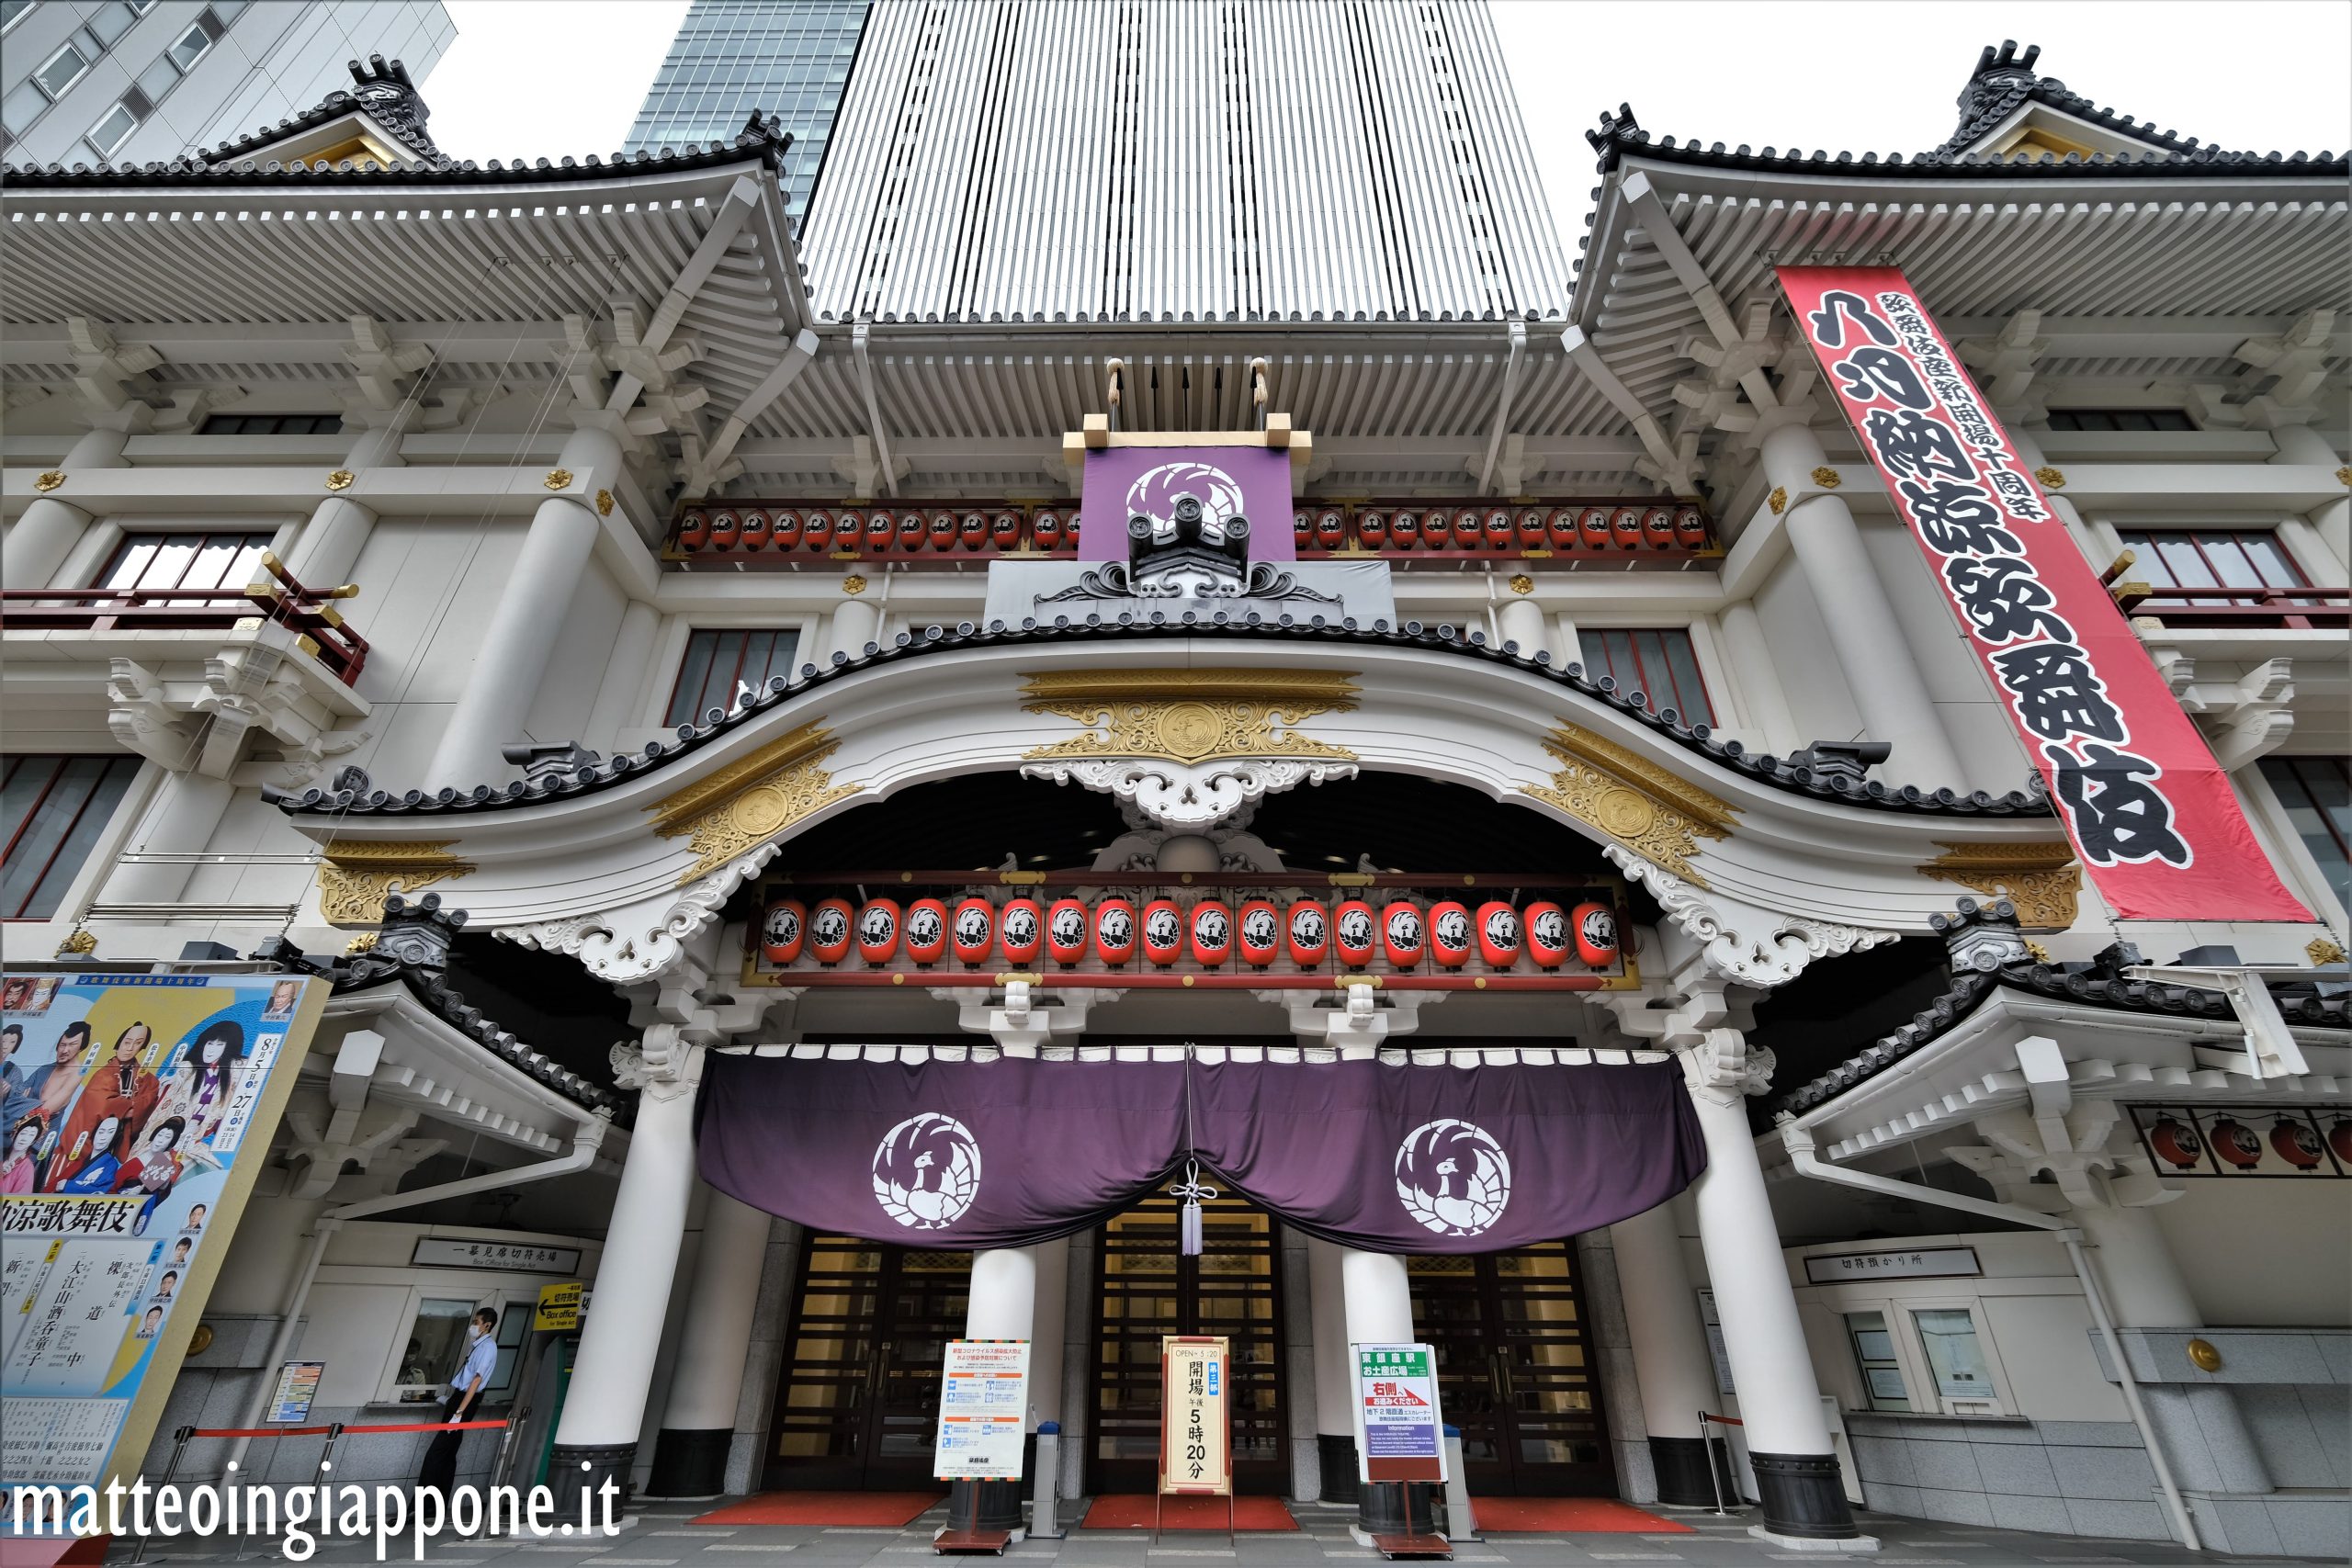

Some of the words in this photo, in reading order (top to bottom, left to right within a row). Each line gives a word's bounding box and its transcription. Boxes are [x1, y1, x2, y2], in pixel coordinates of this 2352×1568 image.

[547, 1311, 559, 1319] Box
[560, 1310, 576, 1318] office
[1363, 1365, 1408, 1376] お土産広場
